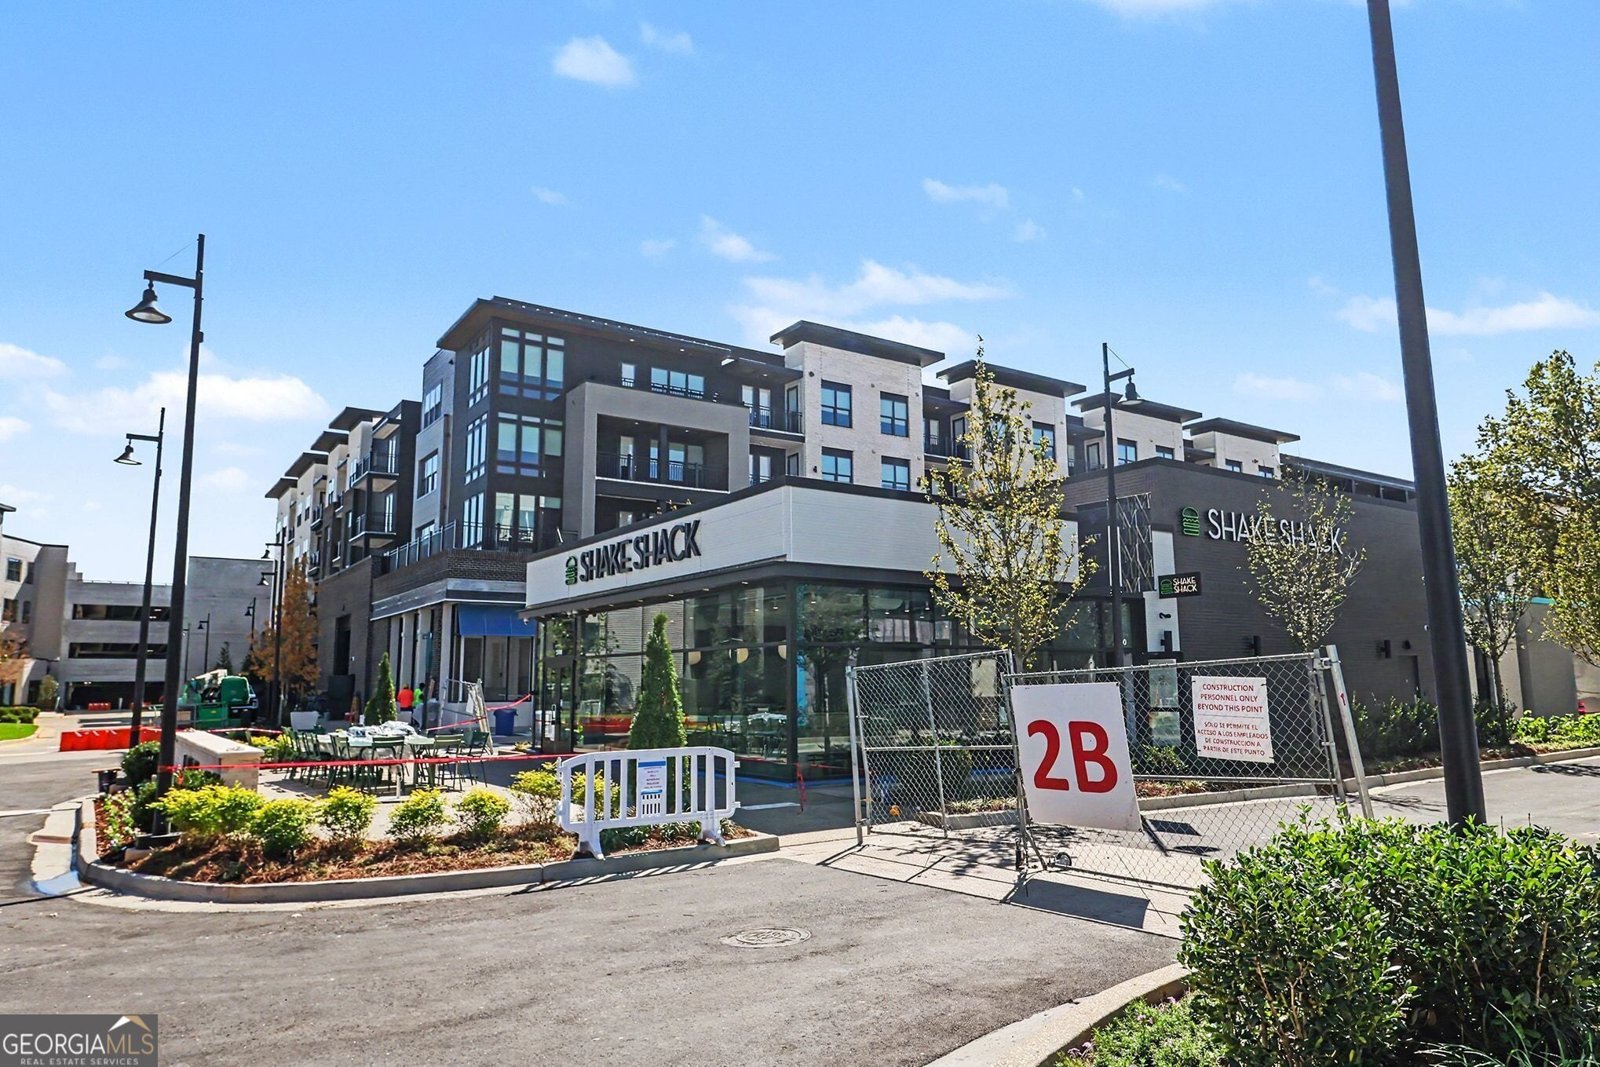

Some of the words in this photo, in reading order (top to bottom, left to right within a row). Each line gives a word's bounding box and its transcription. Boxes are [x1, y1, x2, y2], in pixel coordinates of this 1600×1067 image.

[1208, 509, 1278, 546] SHAKE
[580, 539, 632, 581] SHAKE
[633, 520, 701, 570] SHACK
[1173, 577, 1196, 586] SHAKE
[1174, 585, 1197, 593] SHACK
[1202, 684, 1254, 692] CONSTRUCTION
[1200, 693, 1238, 701] PERSONNEL
[1197, 703, 1224, 711] BEYOND
[1233, 732, 1269, 740] EMPLEADOS
[1244, 748, 1265, 756] PUNTO
[1027, 720, 1118, 793] 2B
